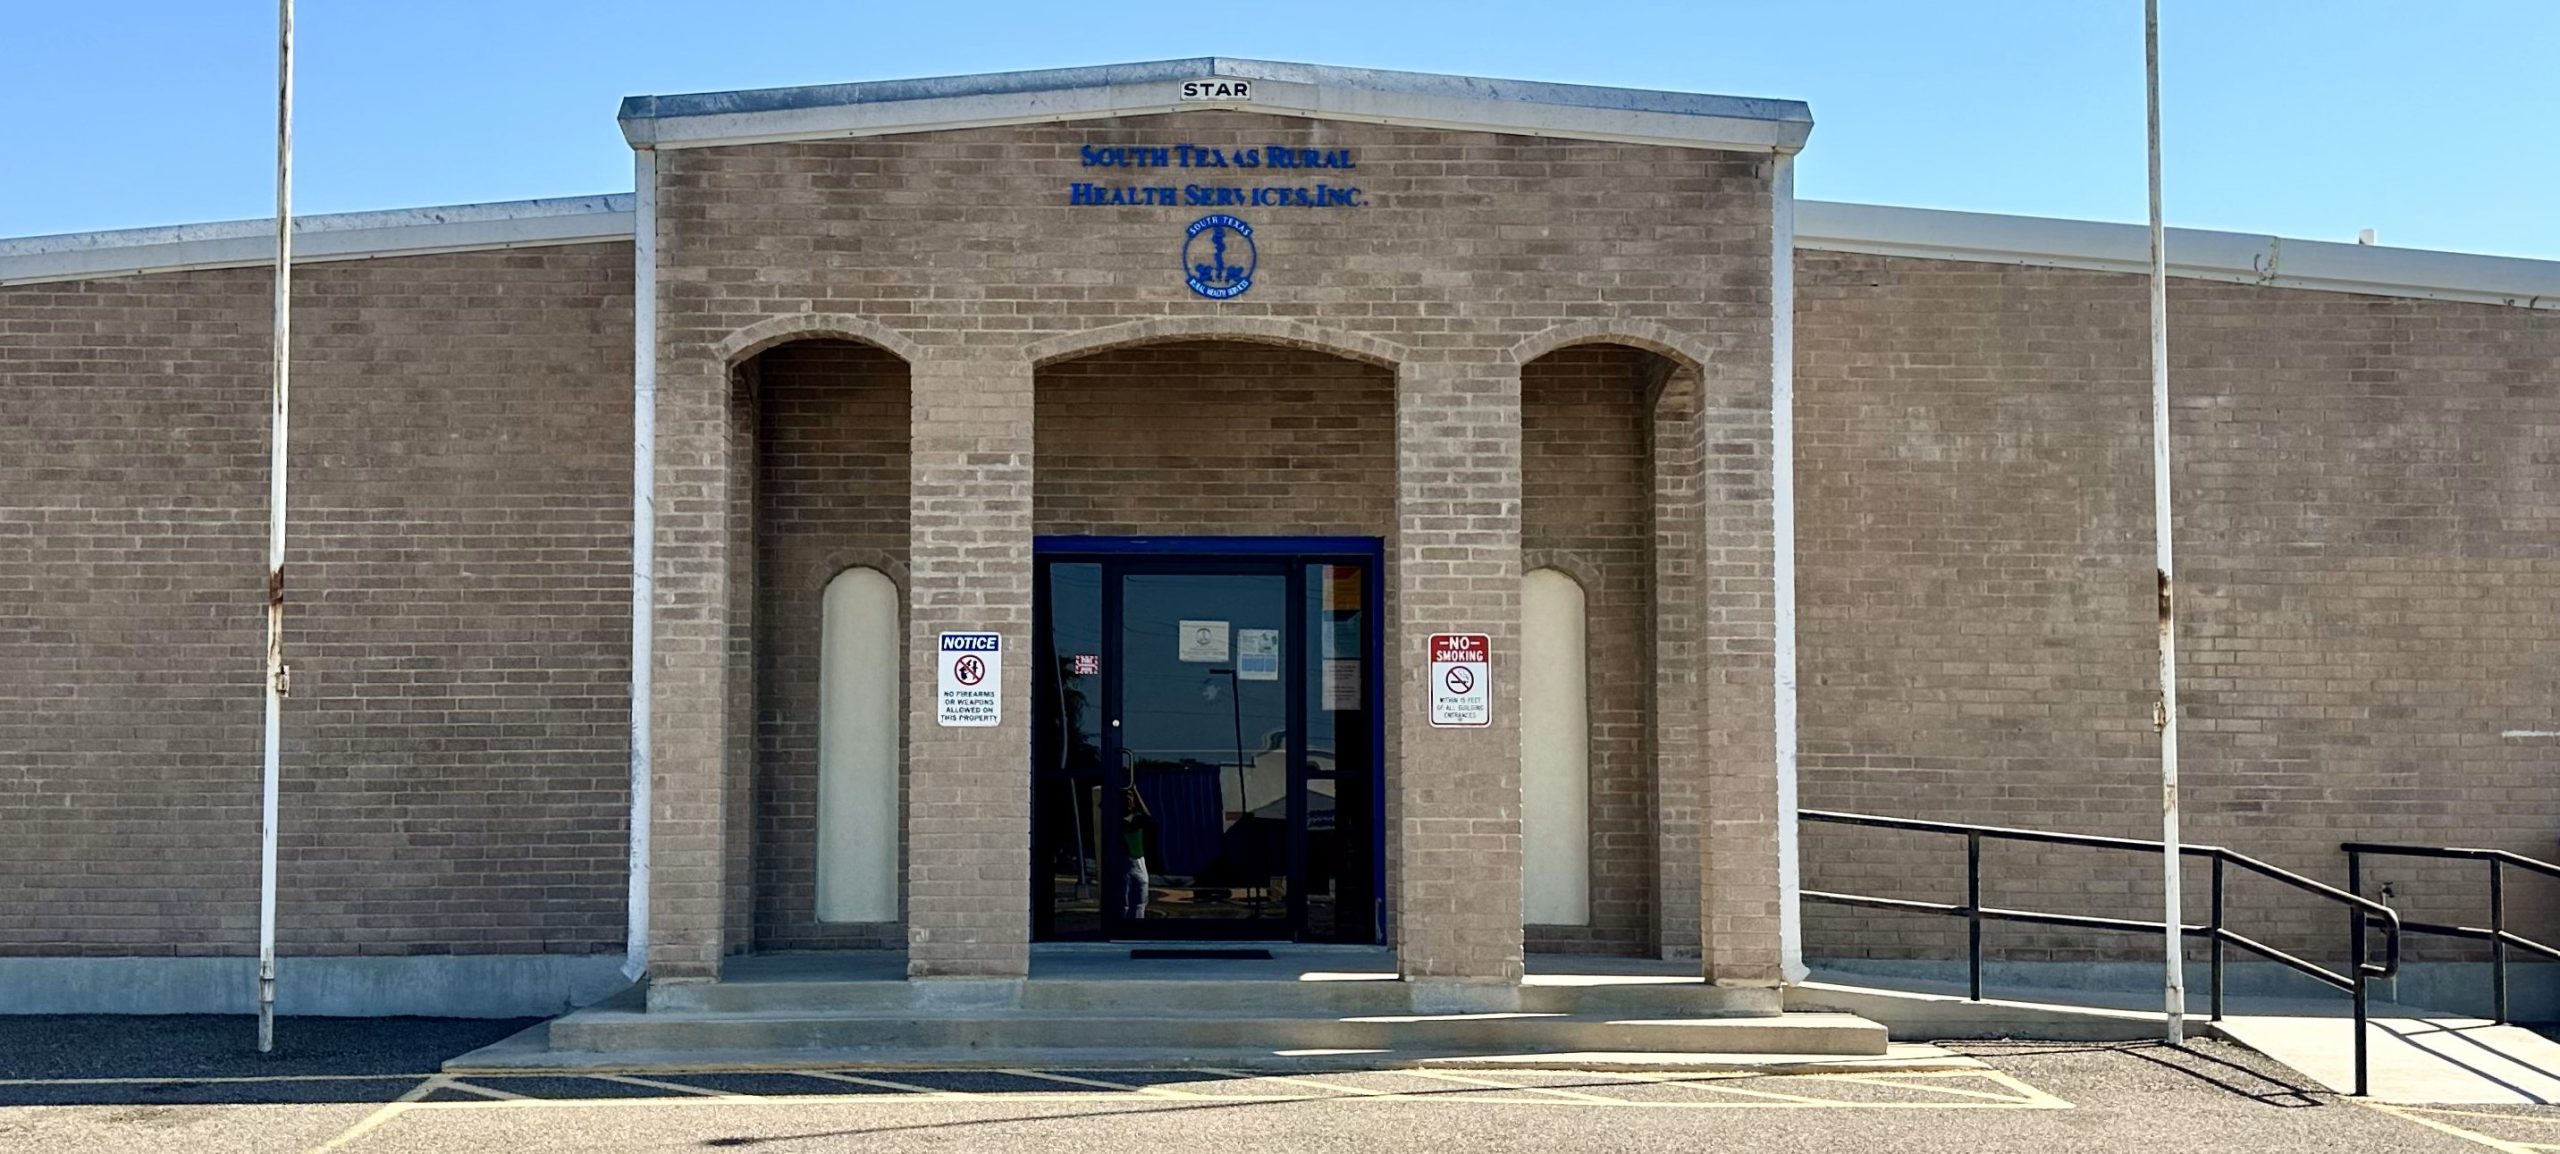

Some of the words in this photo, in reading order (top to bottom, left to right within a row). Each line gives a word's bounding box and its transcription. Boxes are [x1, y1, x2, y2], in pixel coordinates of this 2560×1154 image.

[1184, 83, 1247, 96] STAR
[1081, 144, 1168, 167] SOUTH
[1174, 143, 1260, 168] TEXAS
[1266, 144, 1356, 168] RURAL
[1070, 183, 1178, 206] HEALTH
[1189, 216, 1218, 235] SOUTH
[1223, 216, 1251, 236] TEXAS
[943, 636, 997, 650] NOTICE
[1449, 636, 1470, 650] NO
[1436, 650, 1484, 662] SMOKING
